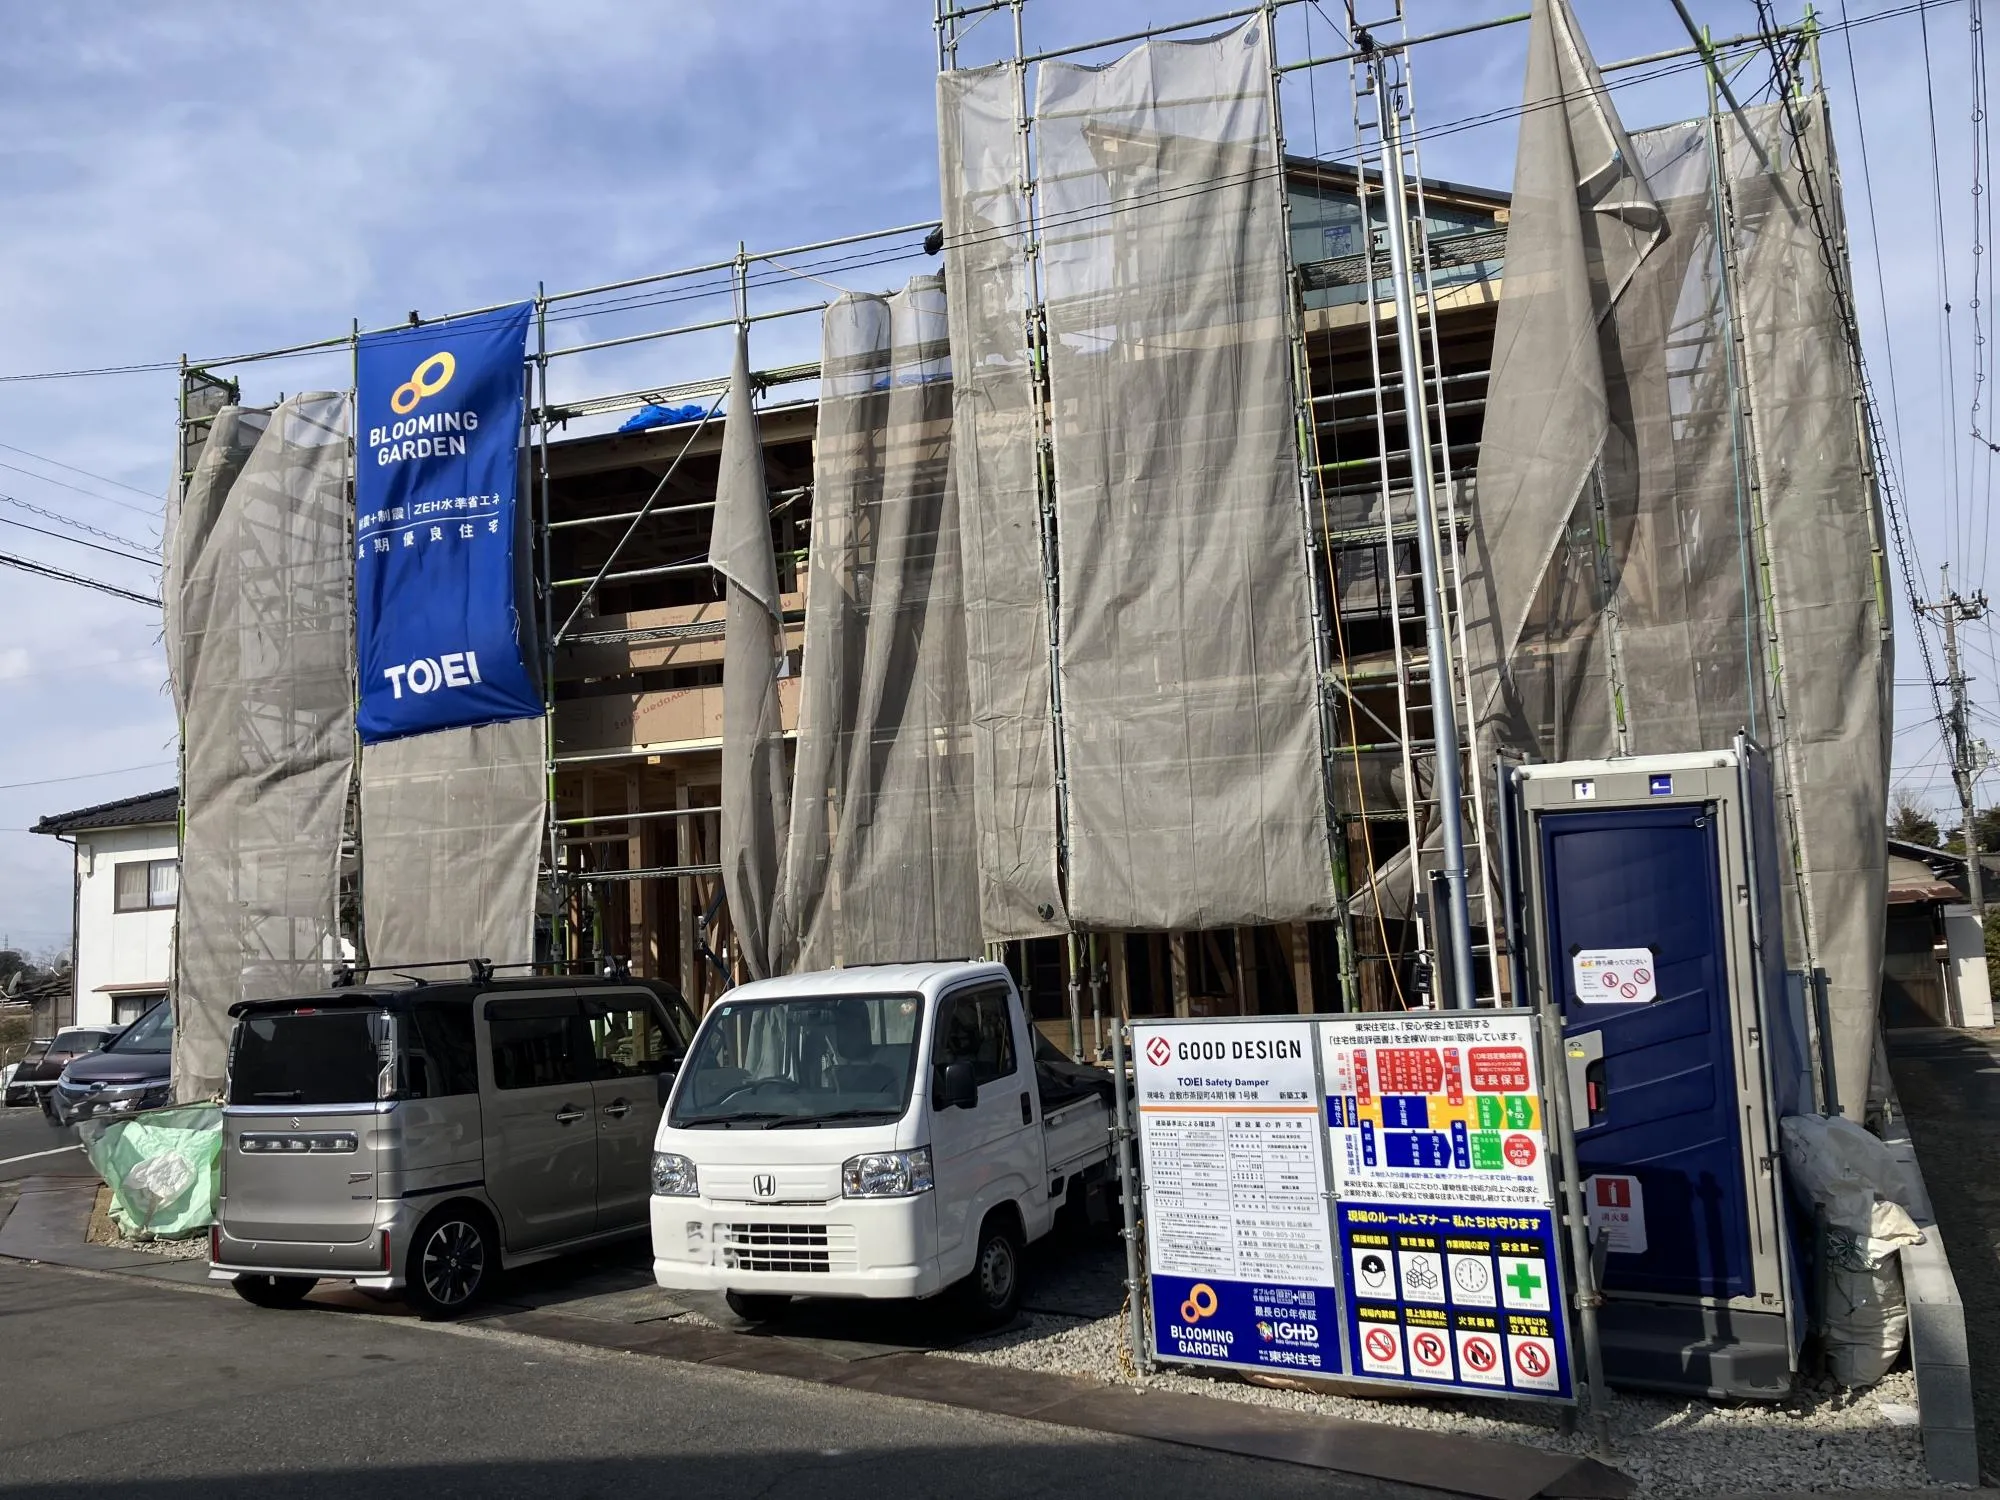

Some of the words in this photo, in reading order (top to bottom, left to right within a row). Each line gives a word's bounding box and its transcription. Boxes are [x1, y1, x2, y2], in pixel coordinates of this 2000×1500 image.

[369, 411, 478, 447] BLOOMING
[378, 436, 466, 466] GARDEN
[384, 651, 482, 699] TOEI
[1177, 1041, 1225, 1059] GOOD
[1232, 1040, 1301, 1058] DESIGN
[1177, 1077, 1202, 1085] TOEI
[1205, 1078, 1232, 1087] Safety
[1235, 1078, 1269, 1087] Damper
[1474, 1074, 1526, 1085] 延長保証
[1146, 1091, 1164, 1099] 現場名
[1279, 1091, 1307, 1099] 新築工事
[1347, 1209, 1450, 1226] 現場のルールとマナー
[1452, 1214, 1541, 1231] 私たちは守ります
[1501, 1242, 1539, 1253] 安全第一
[1254, 1306, 1317, 1320] 最長60年保証
[1508, 1316, 1547, 1326] 関係者以外
[1170, 1325, 1234, 1343] BLOOMING
[1510, 1324, 1548, 1336] 立入禁止
[1178, 1340, 1228, 1357] GARDEN
[1269, 1350, 1321, 1366] 東栄住宅
